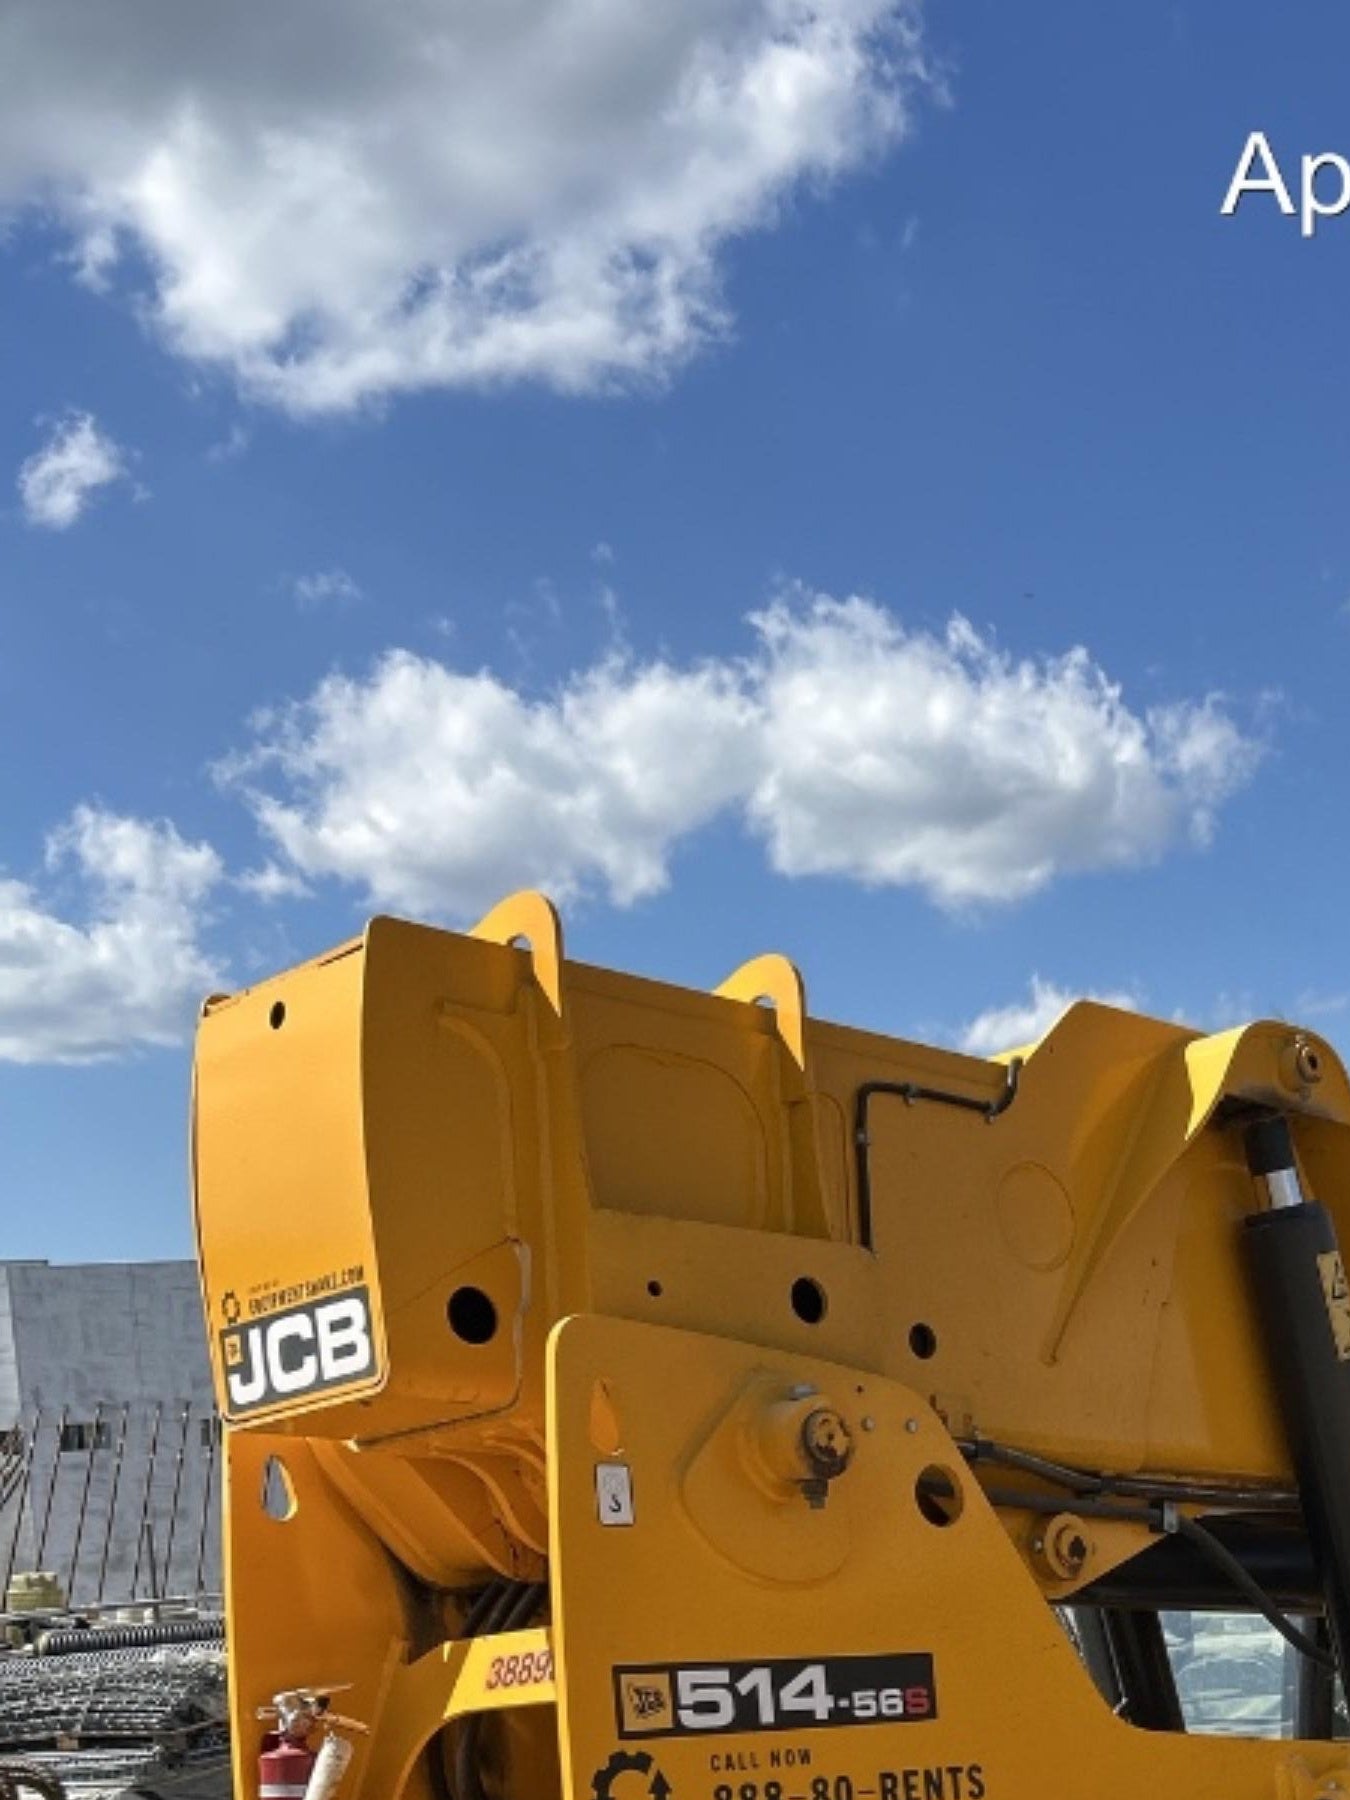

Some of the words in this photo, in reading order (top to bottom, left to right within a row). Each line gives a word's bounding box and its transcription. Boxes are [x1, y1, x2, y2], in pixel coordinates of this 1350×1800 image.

[229, 1298, 371, 1404] JCB
[677, 1664, 930, 1729] 514-56S
[710, 1753, 760, 1771] CALL
[769, 1748, 812, 1768] NOW
